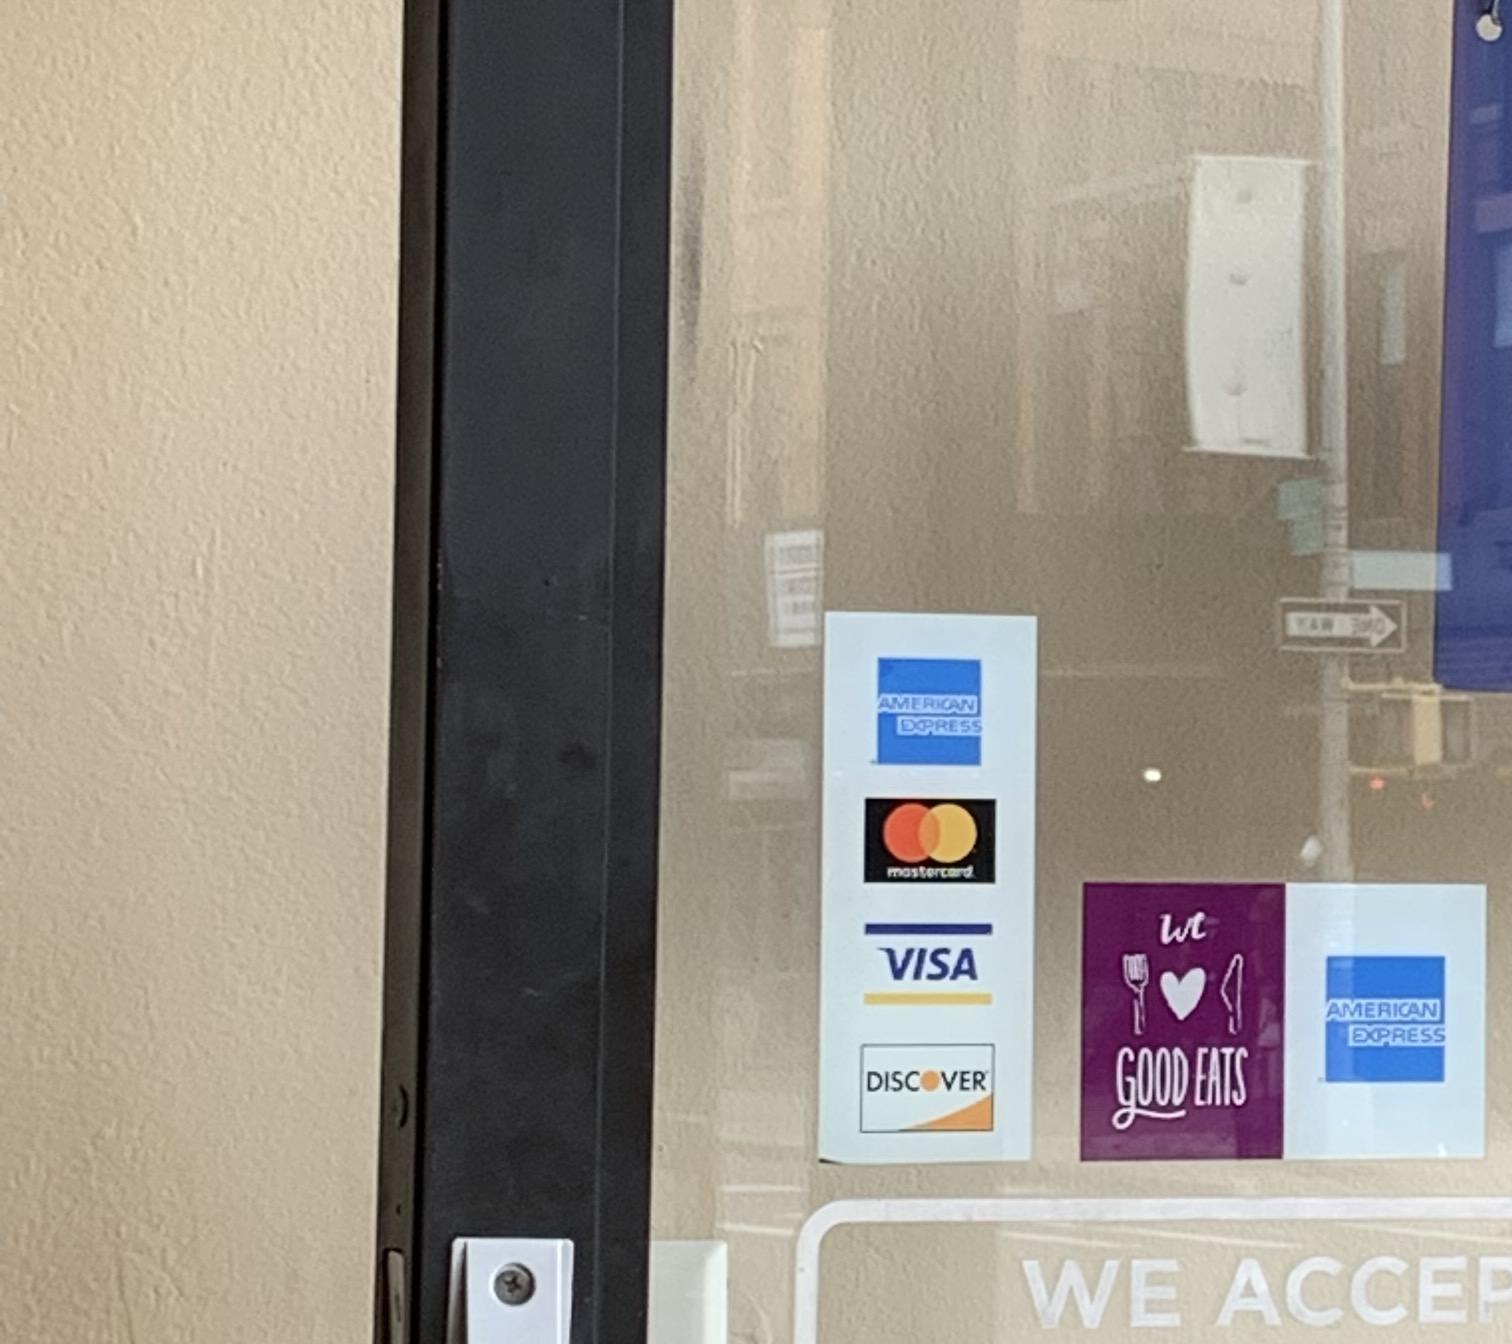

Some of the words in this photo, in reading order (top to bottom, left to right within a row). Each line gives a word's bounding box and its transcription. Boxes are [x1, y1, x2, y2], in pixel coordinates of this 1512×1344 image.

[879, 695, 976, 714] AMERICAN
[899, 718, 982, 734] EXPRESS
[887, 866, 974, 880] mastercard
[878, 947, 978, 981] VISA
[1326, 999, 1438, 1020] AMERICAN
[1351, 1026, 1446, 1045] EXPRESS
[866, 1069, 988, 1092] DISCOVER
[1112, 1047, 1189, 1130] GOOD
[1196, 1046, 1249, 1107] EATS
[1023, 1259, 1181, 1329] WE
